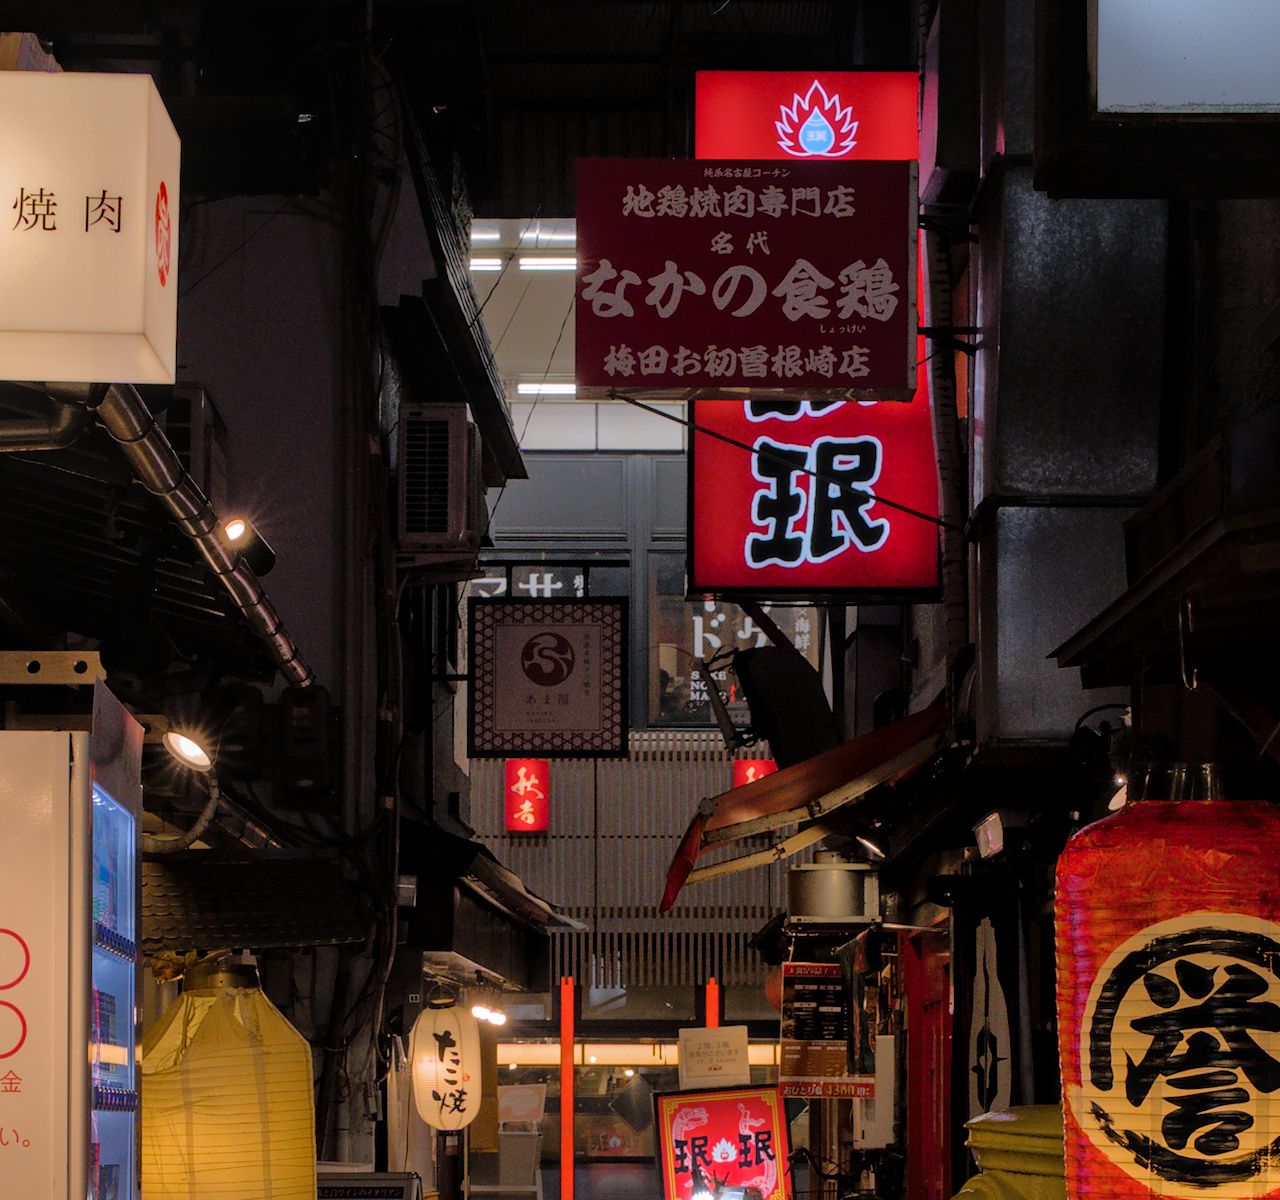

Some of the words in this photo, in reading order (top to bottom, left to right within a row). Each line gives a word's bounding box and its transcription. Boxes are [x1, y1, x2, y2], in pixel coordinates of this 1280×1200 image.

[13, 187, 123, 234] 焼肉
[622, 184, 856, 219] 地鶏焼肉専門店
[710, 231, 770, 255] 名代
[581, 258, 900, 322] なかの食鶏
[603, 344, 871, 378] 梅田お初曽根崎店
[744, 401, 890, 568] 珉
[432, 1030, 468, 1115] たこ焼
[675, 1136, 712, 1174] 珉
[738, 1131, 775, 1168] 珉
[318, 1187, 402, 1199] と白ワインのイタリアン
